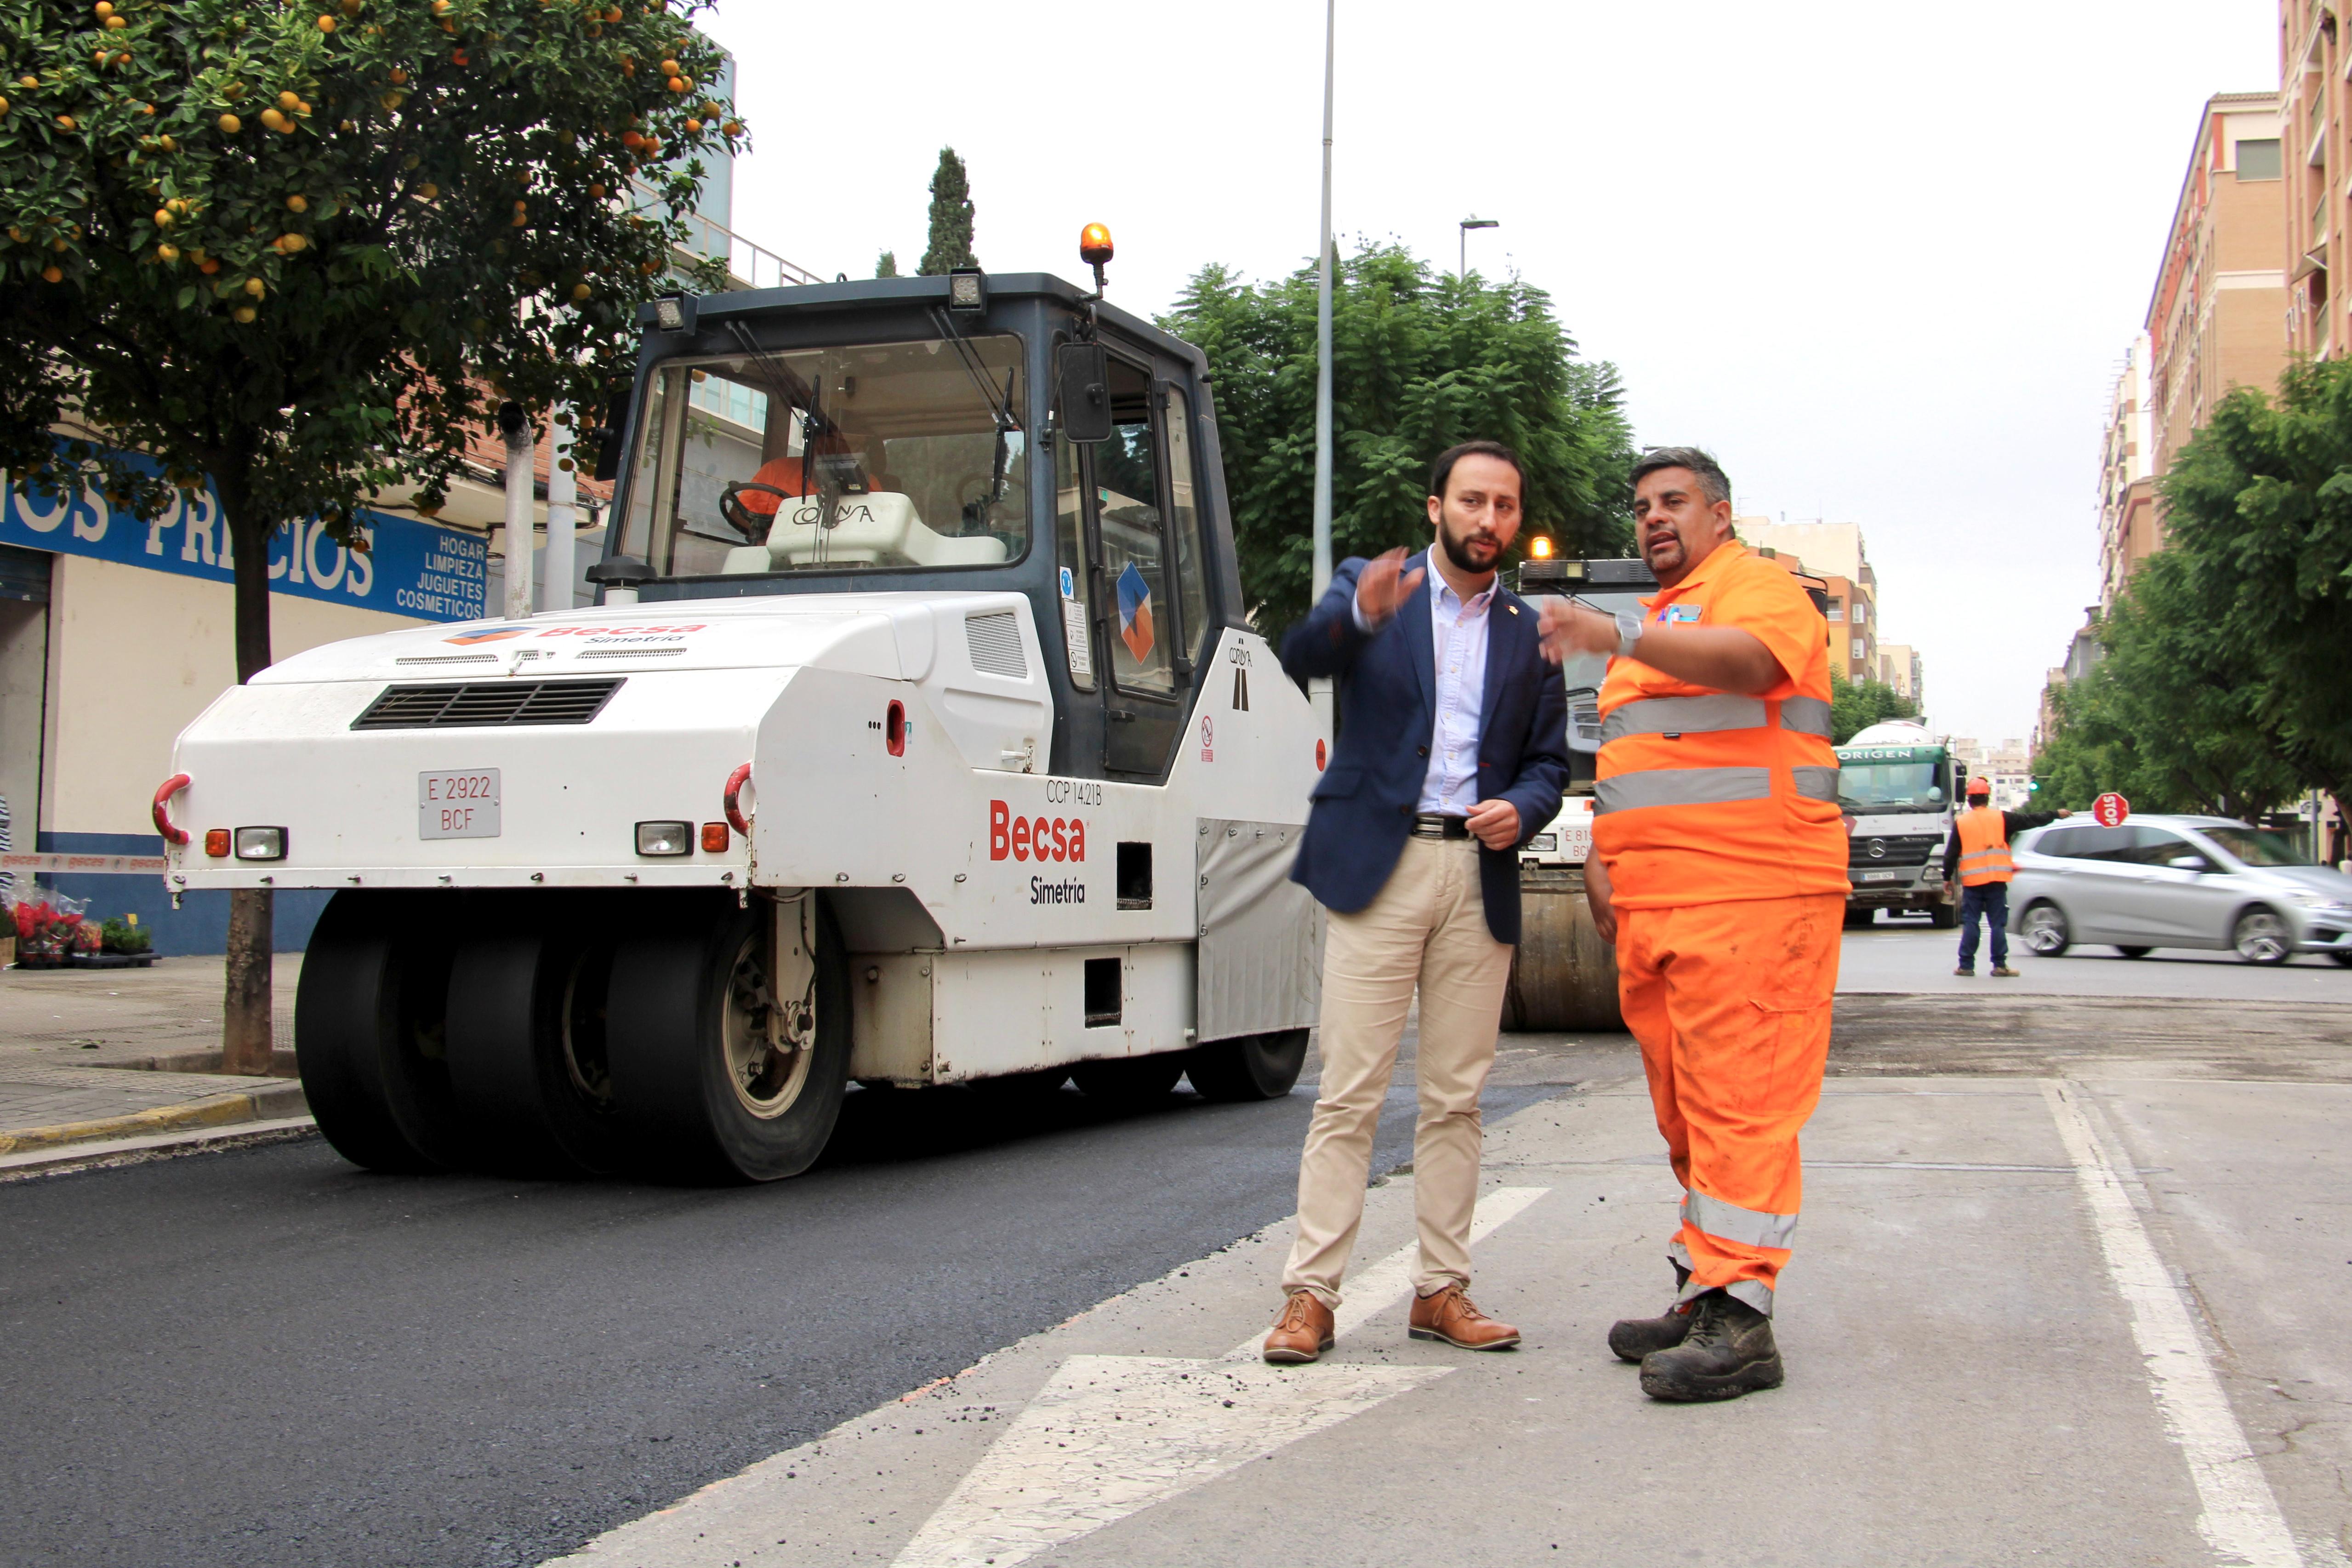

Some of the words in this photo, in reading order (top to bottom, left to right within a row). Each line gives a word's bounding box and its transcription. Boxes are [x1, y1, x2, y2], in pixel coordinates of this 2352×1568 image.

[439, 535, 484, 560] HOGAR
[425, 552, 483, 580] LIMPIEZA
[417, 572, 483, 601] JUGUETES
[396, 588, 482, 619] COSMETICOS
[536, 624, 707, 637] Becsa
[1838, 750, 1912, 760] ORIGEN
[428, 779, 439, 800] E
[446, 776, 490, 799] 2922
[1047, 780, 1070, 804] CCP
[1073, 782, 1102, 805] 14.21B
[441, 809, 474, 831] BCF
[2103, 796, 2118, 826] STOP
[990, 799, 1085, 862] Becsa
[1566, 830, 1572, 841] E
[1030, 875, 1085, 905] Simetría
